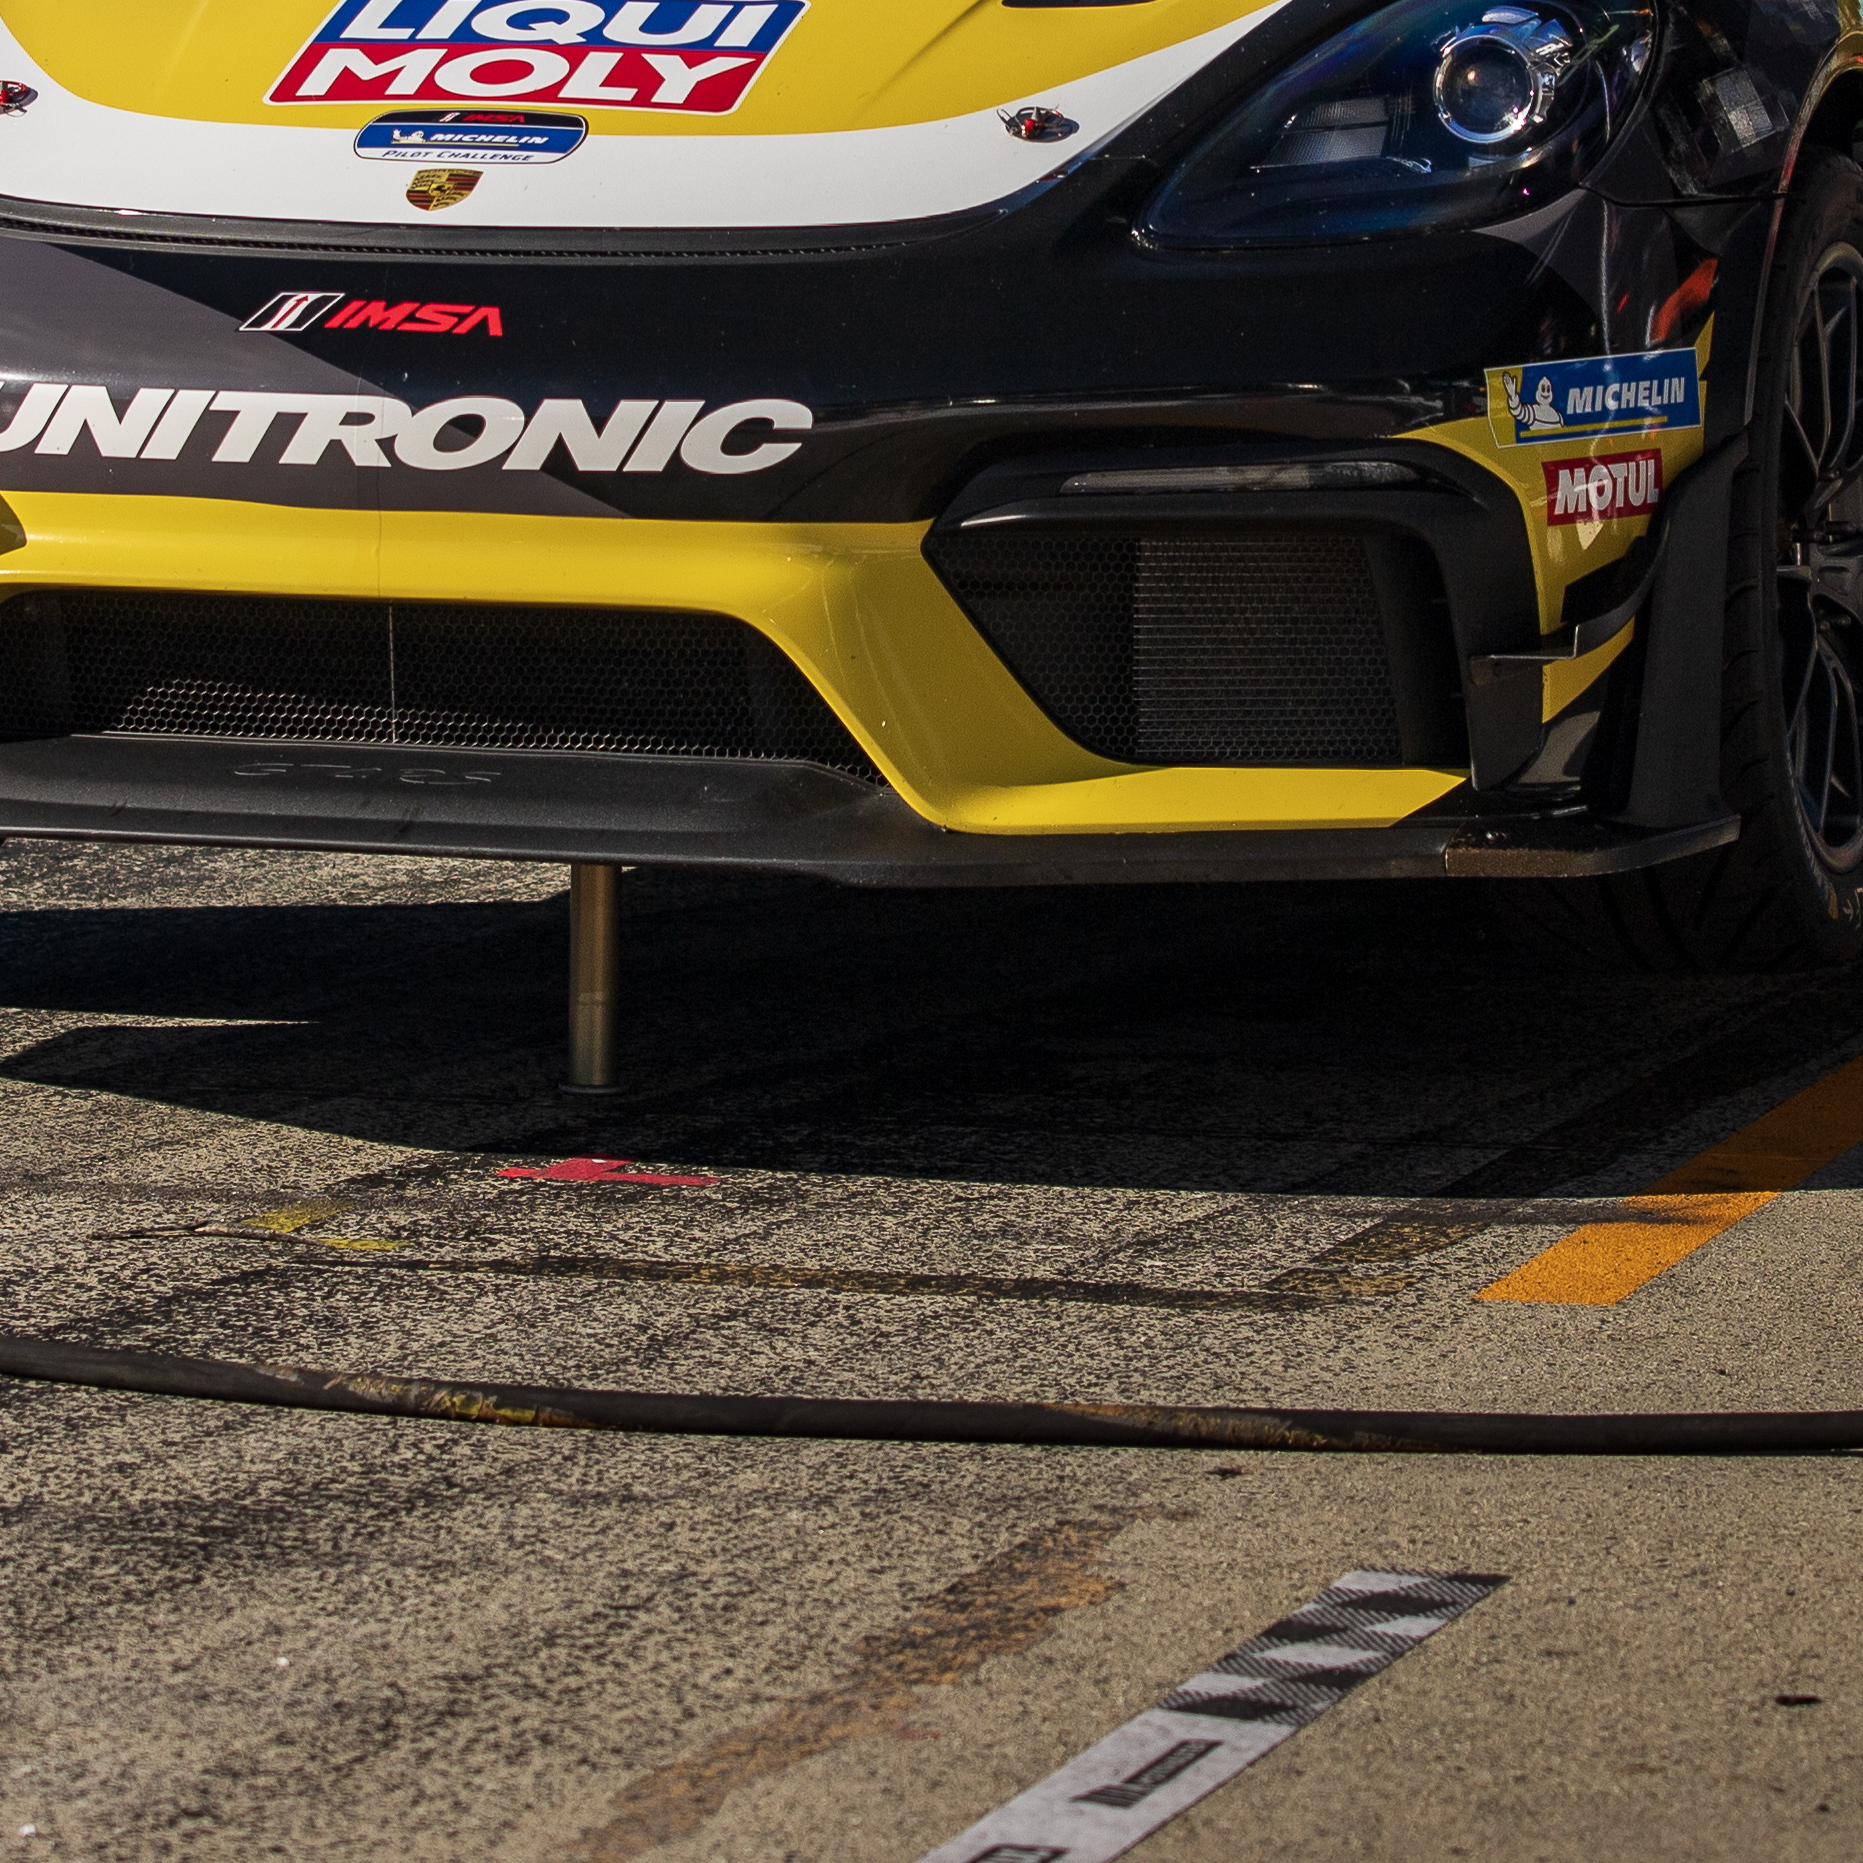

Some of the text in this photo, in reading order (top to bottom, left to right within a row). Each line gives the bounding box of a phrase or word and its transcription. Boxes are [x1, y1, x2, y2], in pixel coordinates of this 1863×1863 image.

[295, 47, 756, 104] MOLY
[461, 113, 526, 124] IMSA
[381, 149, 535, 162] PILOT CHALLENGE
[430, 132, 550, 145] MICHELIN
[324, 298, 503, 337] IMSA
[1566, 377, 1686, 416] MICHELIN
[1554, 458, 1660, 516] MOTUL
